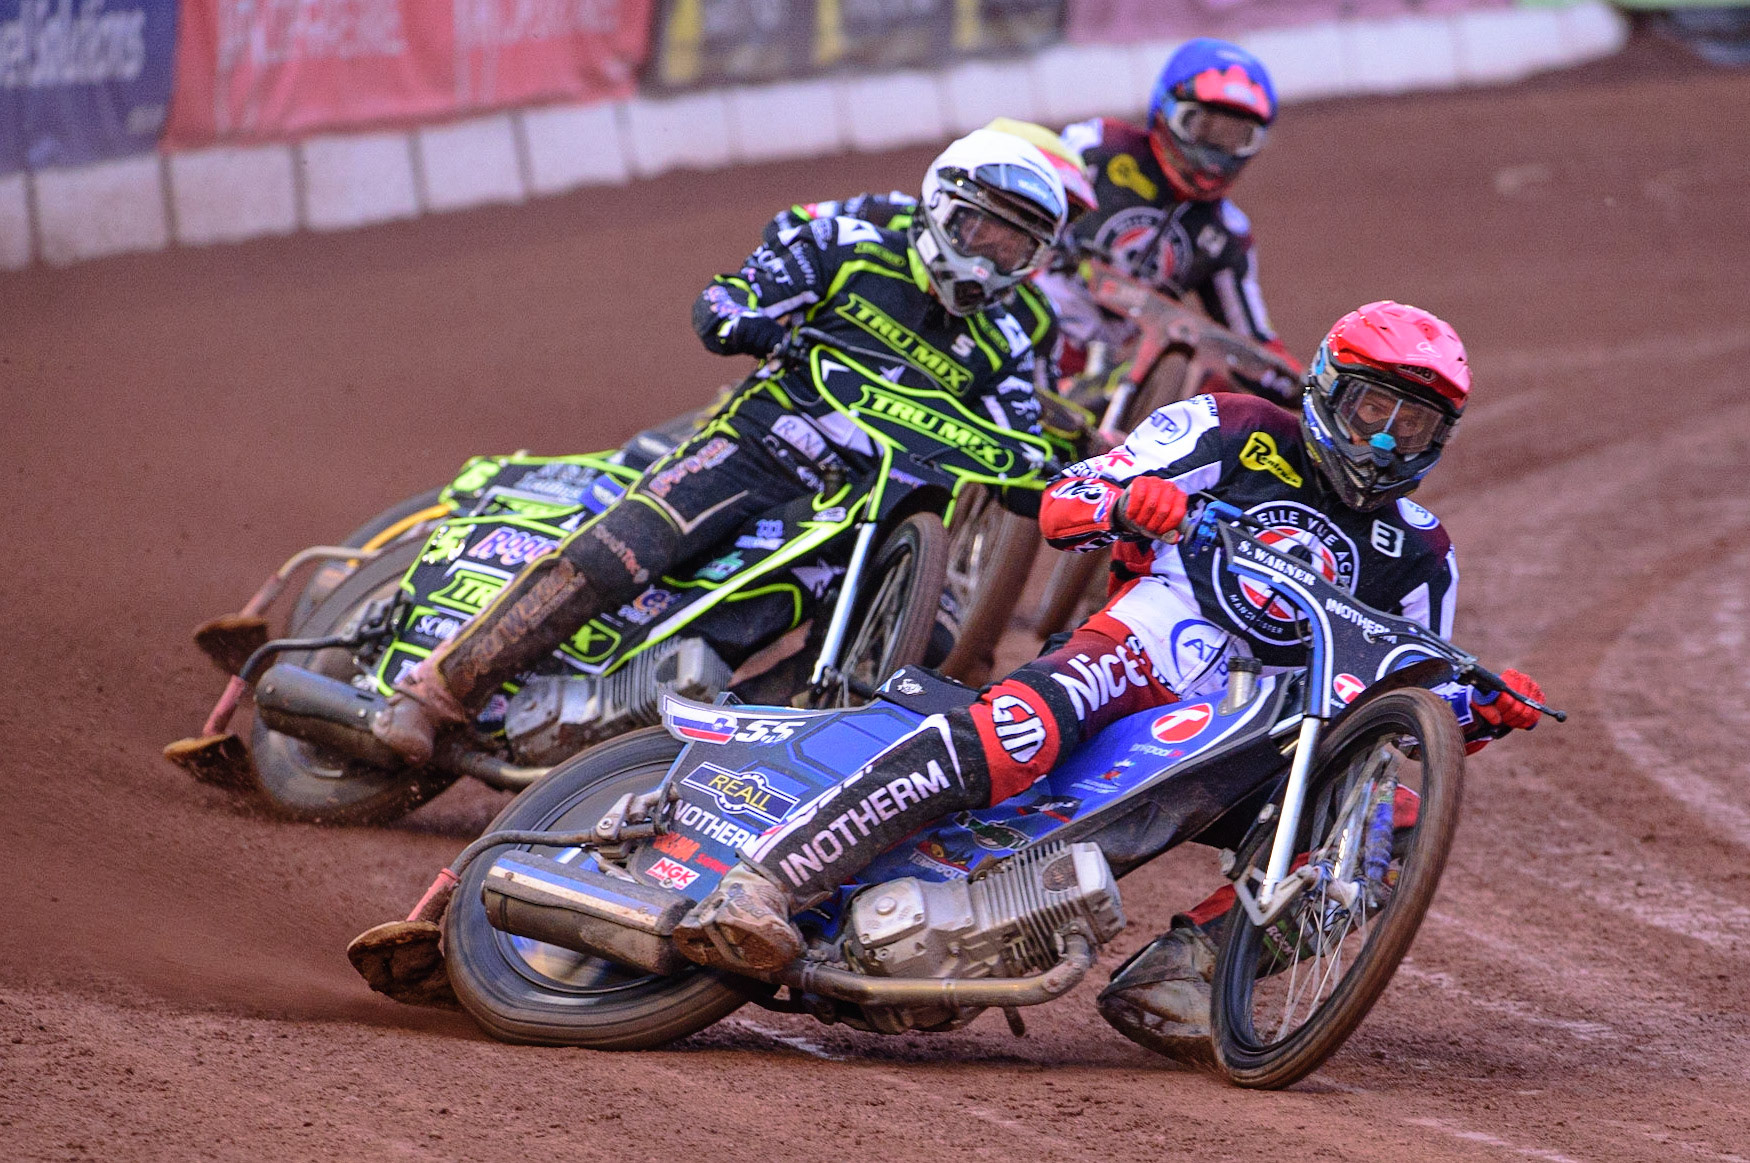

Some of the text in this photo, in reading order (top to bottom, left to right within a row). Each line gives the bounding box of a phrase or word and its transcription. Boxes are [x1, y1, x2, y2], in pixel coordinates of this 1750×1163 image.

[855, 303, 969, 390] TRU MIX
[871, 393, 1004, 464] TRU MIX
[707, 773, 772, 812] REALL
[778, 759, 951, 888] INOTHERM
[654, 858, 697, 886] NGK
